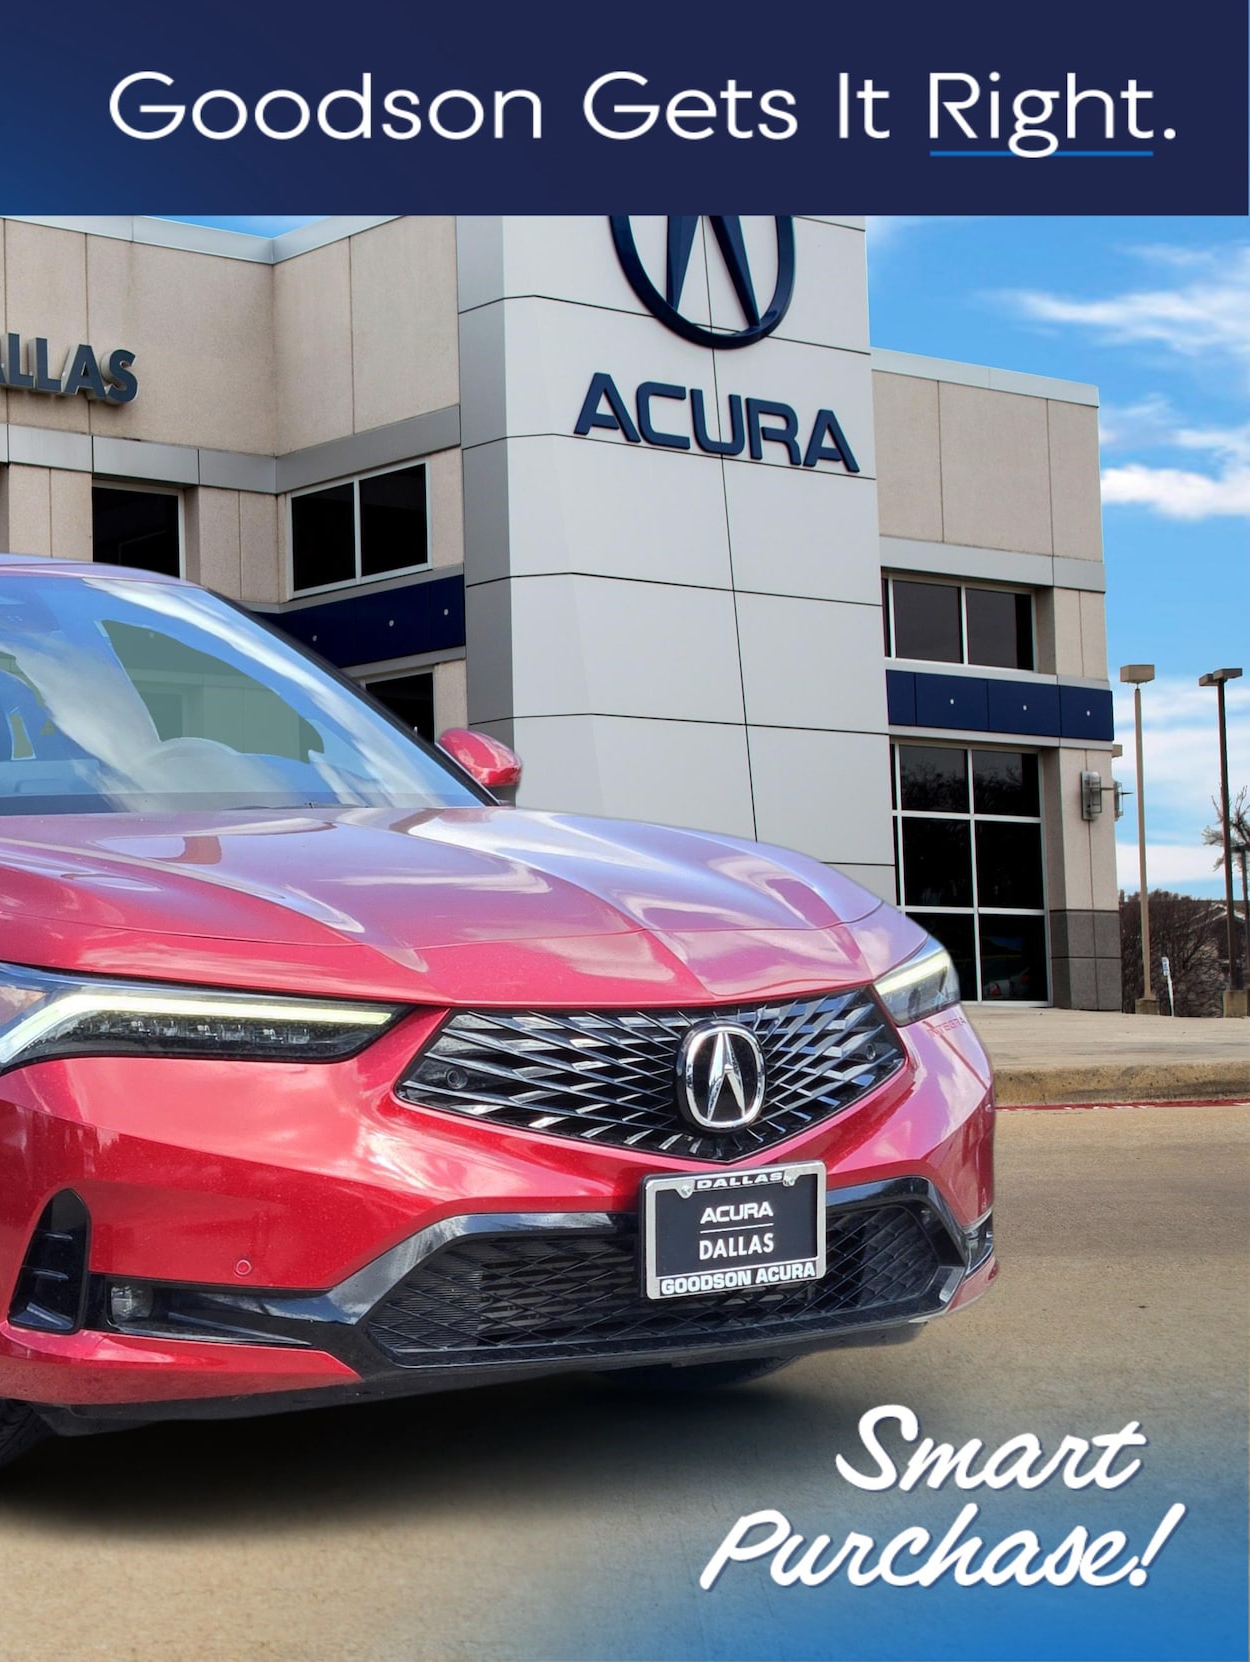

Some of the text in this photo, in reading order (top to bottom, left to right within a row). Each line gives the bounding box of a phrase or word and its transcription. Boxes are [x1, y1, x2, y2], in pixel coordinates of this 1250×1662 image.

[573, 371, 860, 475] ACURA
[696, 1173, 783, 1189] DALLAS
[700, 1202, 773, 1224] ACURA
[699, 1233, 774, 1260] DALLAS
[661, 1262, 816, 1295] GOODSON ACURA
